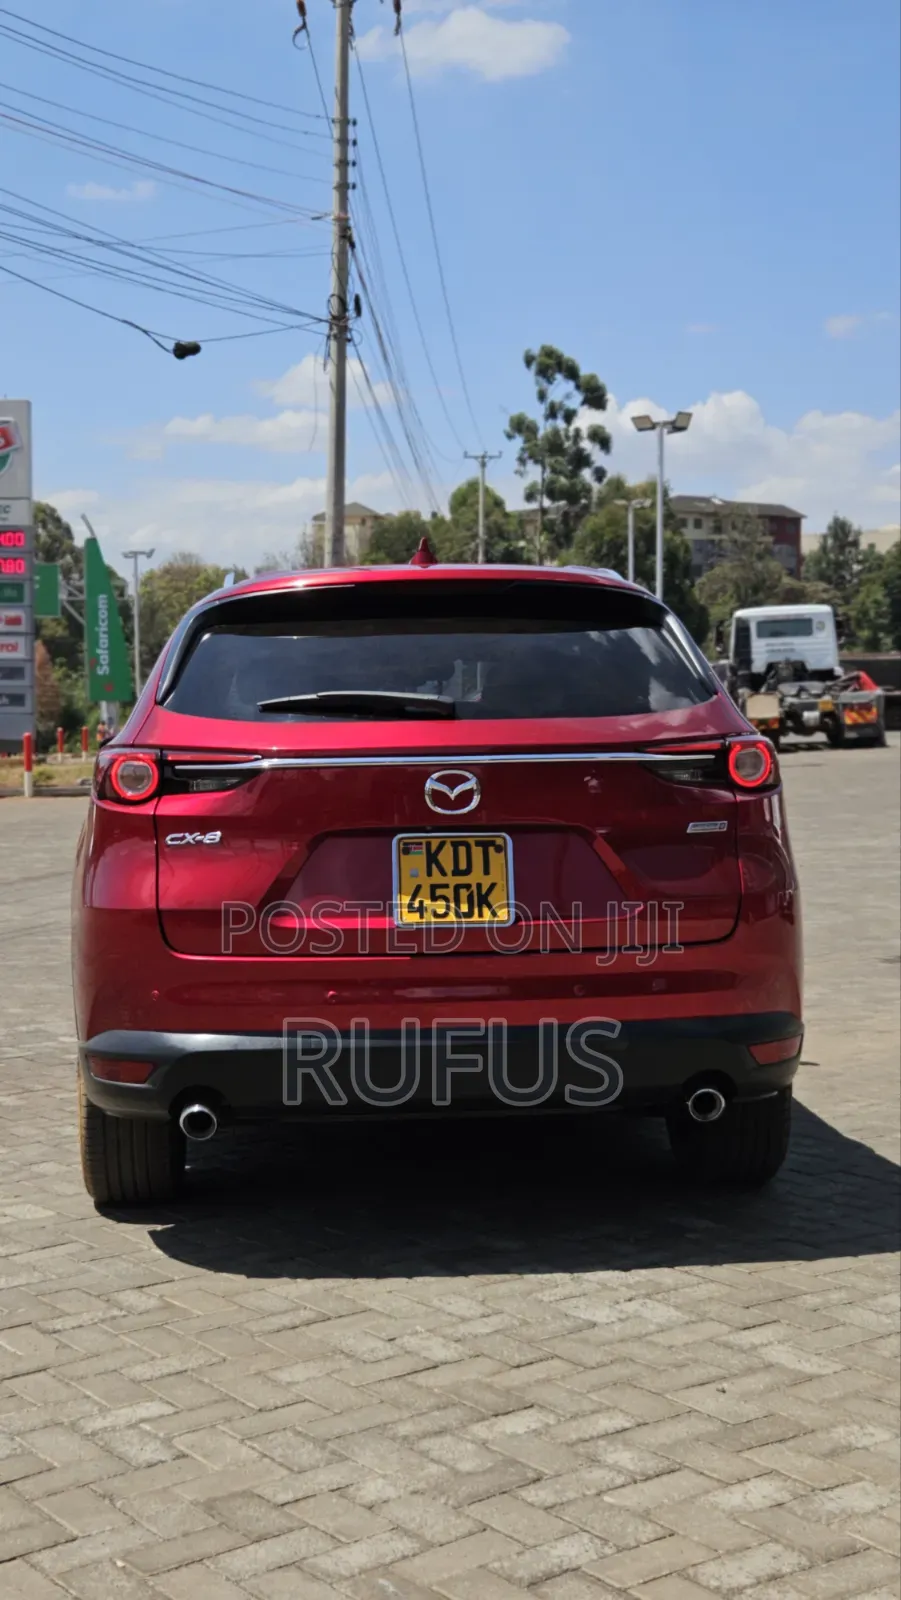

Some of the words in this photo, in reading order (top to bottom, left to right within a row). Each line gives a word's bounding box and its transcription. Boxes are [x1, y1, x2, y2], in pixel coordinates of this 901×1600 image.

[95, 594, 109, 675] Safaricom
[165, 831, 222, 845] CX-8
[424, 840, 500, 877] KDT
[407, 882, 499, 919] 450K
